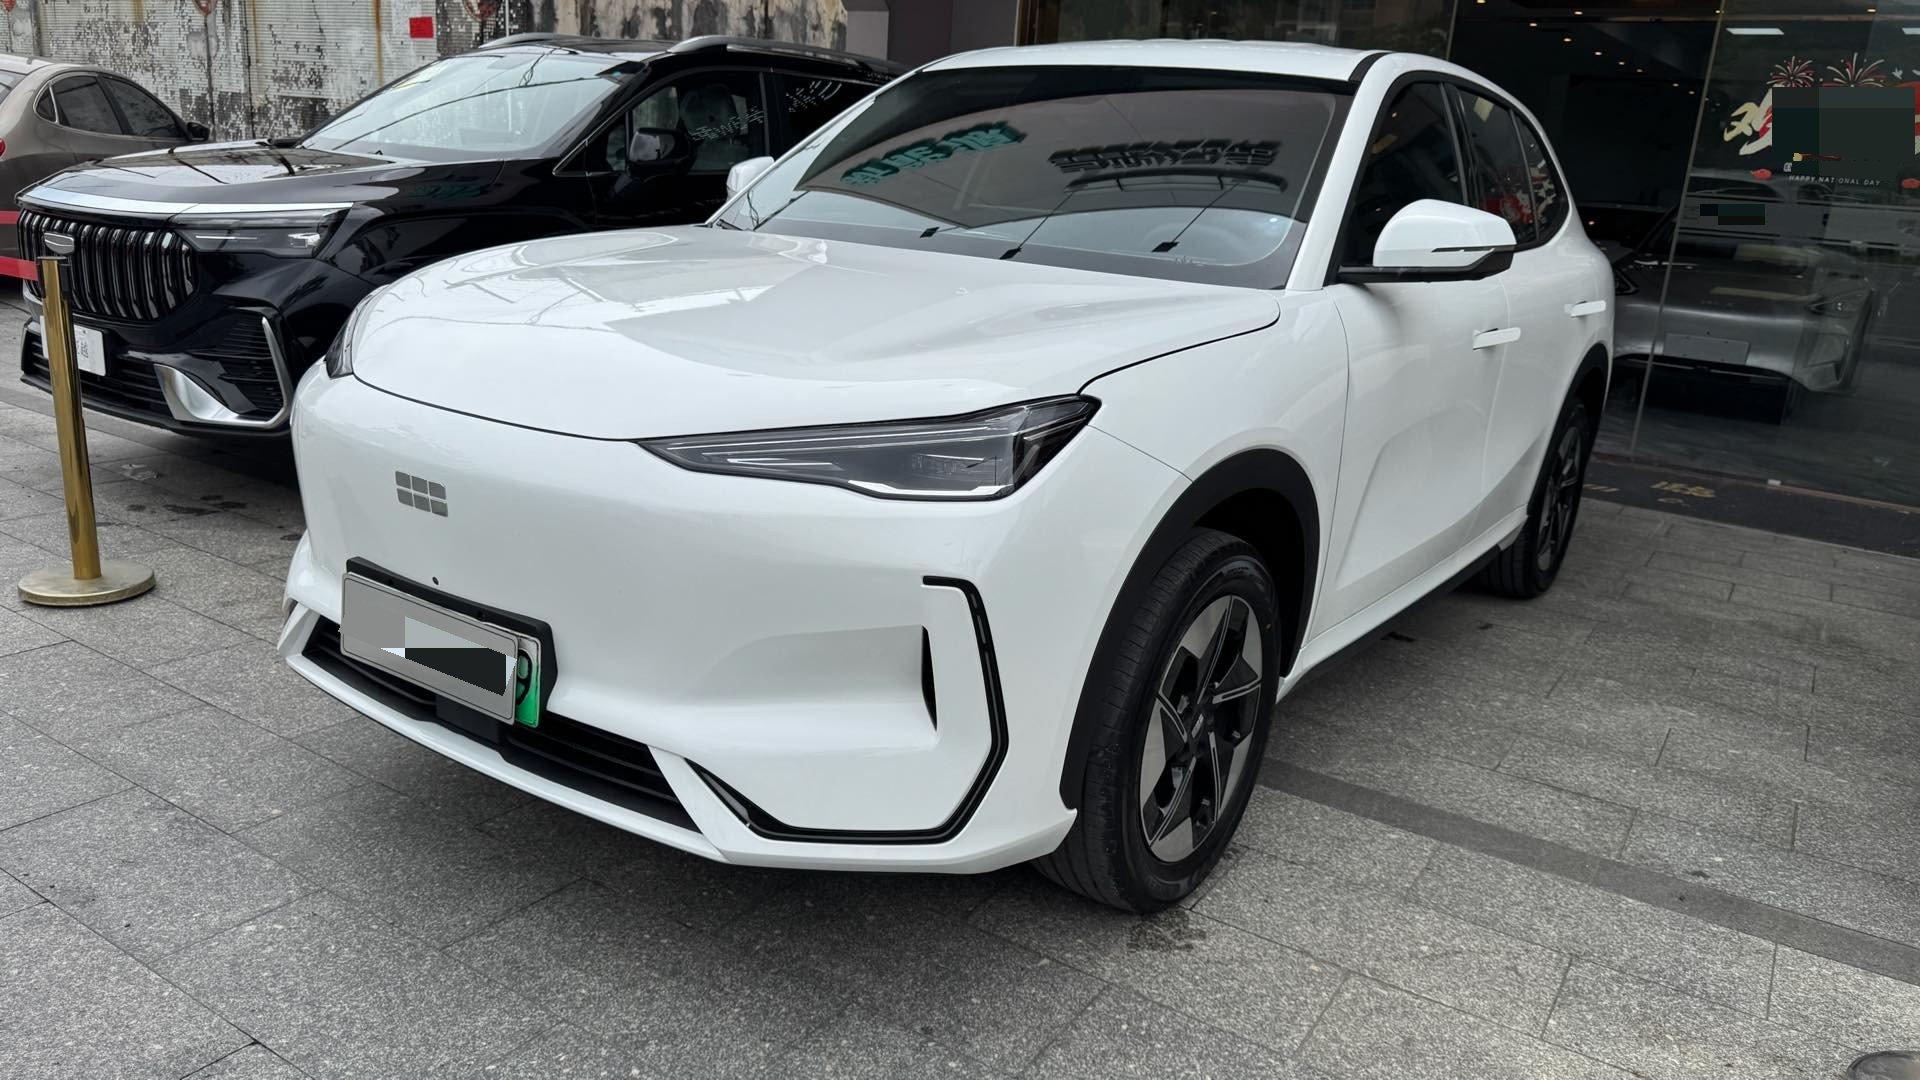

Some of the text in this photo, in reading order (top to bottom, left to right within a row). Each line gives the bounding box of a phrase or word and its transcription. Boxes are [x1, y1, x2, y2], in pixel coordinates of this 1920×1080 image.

[1788, 175, 1881, 187] HAPPY NATONAL DAY
